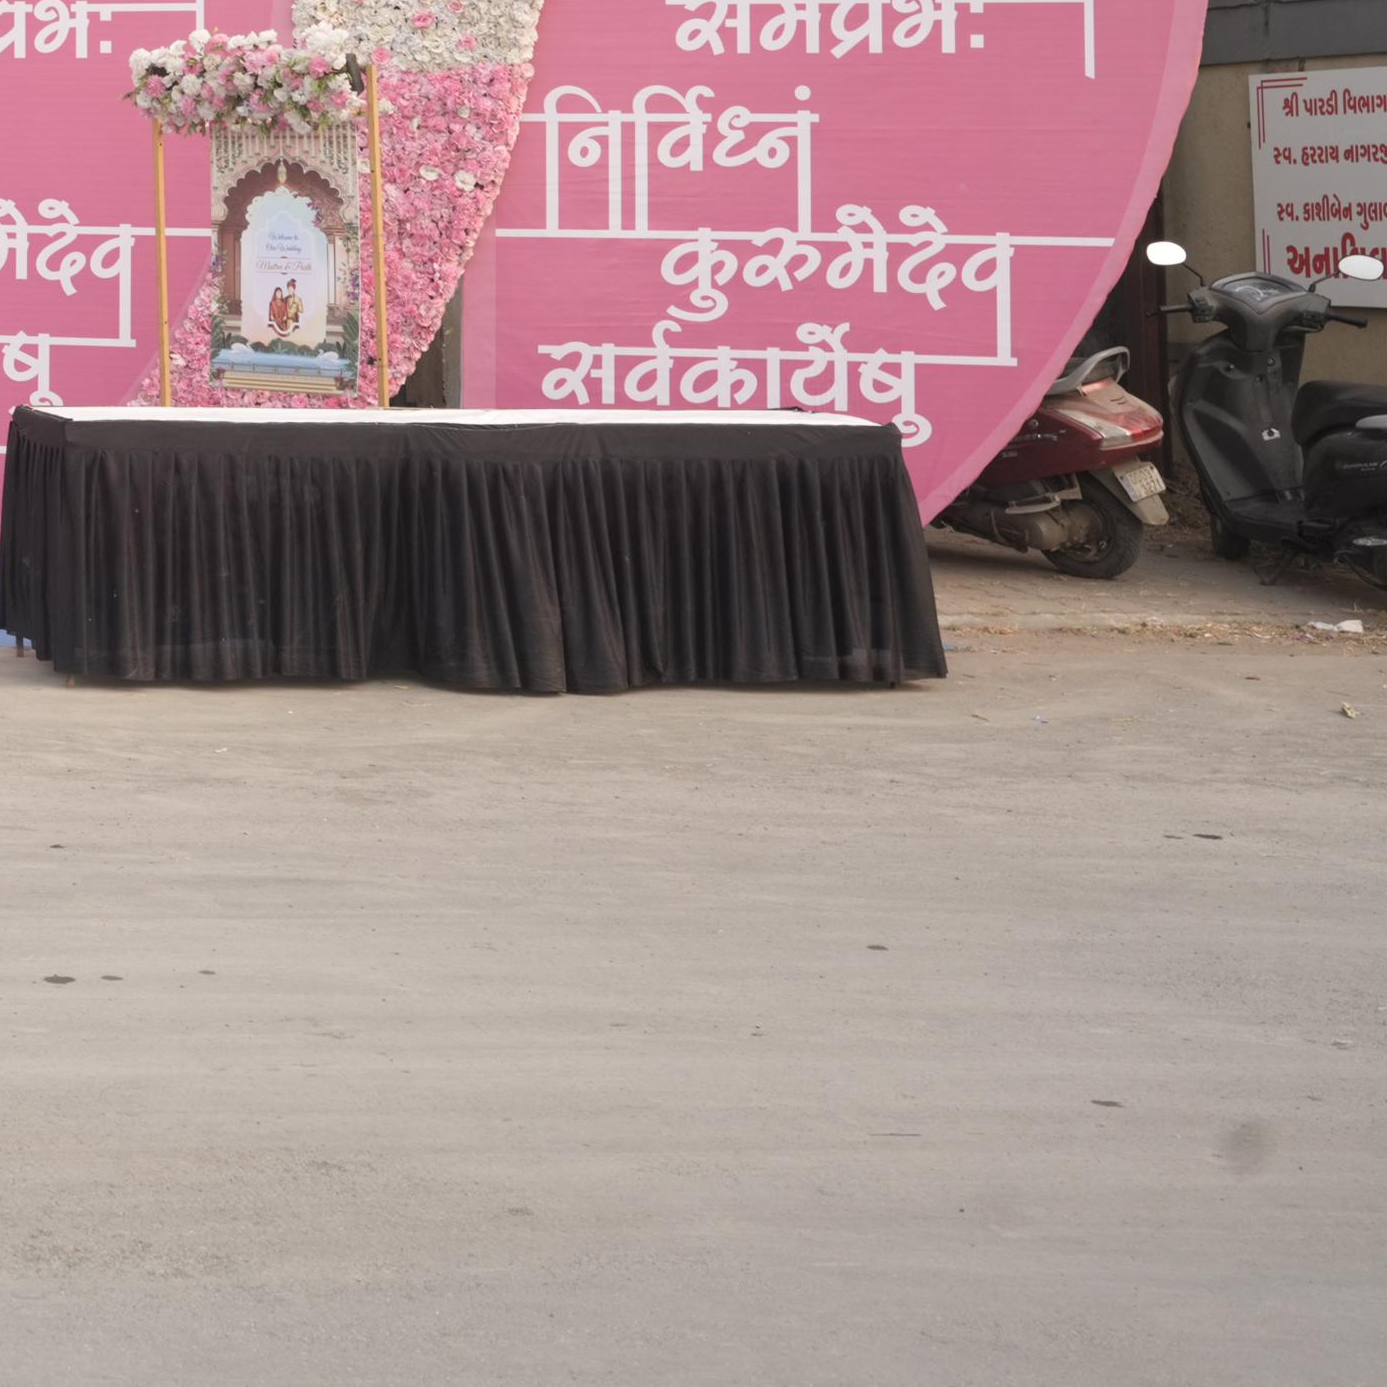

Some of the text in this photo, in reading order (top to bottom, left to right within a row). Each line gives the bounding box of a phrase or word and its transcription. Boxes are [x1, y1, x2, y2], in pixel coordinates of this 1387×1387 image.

[1282, 92, 1299, 117] શ્રી
[1303, 89, 1338, 116] પારડી
[1303, 194, 1352, 221] કાશીબેન
[1356, 202, 1387, 230] ગુલા
[660, 204, 1014, 357] कुरुमेदेव
